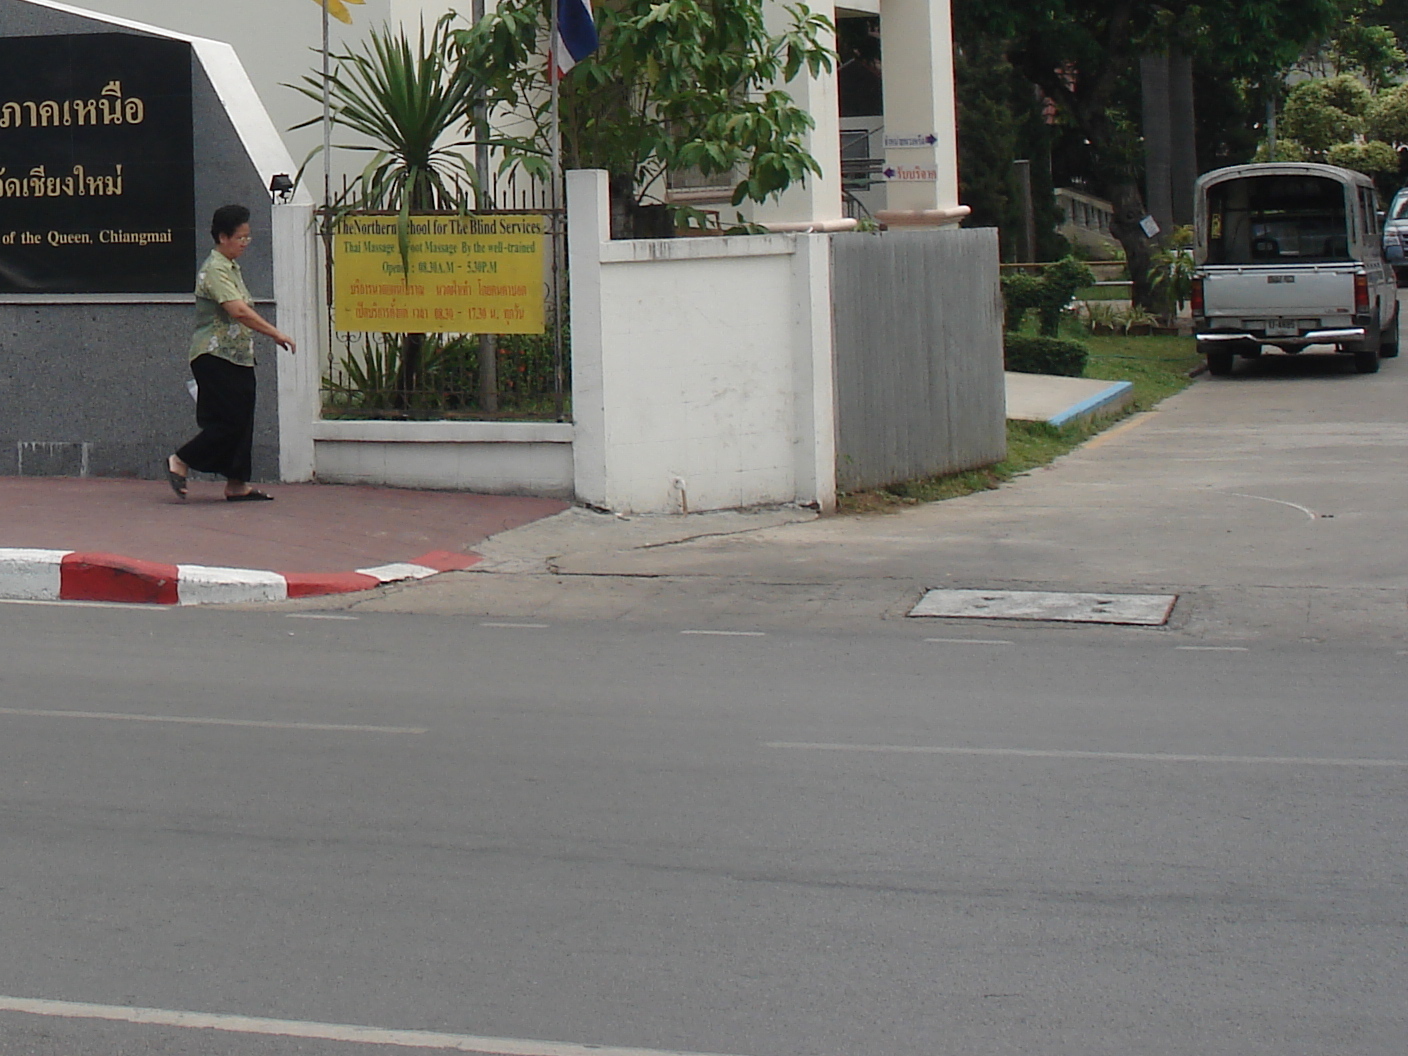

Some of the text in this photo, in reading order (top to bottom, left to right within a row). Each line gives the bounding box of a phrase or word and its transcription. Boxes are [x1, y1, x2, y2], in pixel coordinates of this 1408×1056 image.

[433, 219, 448, 235] for
[470, 219, 497, 235] Blind
[499, 219, 541, 235] Services
[2, 231, 16, 245] of
[21, 231, 42, 245] the
[99, 229, 172, 247] Chiangmai
[344, 241, 361, 253] Thai
[363, 241, 395, 255] Massage
[425, 241, 457, 255] Massage
[473, 241, 485, 253] the
